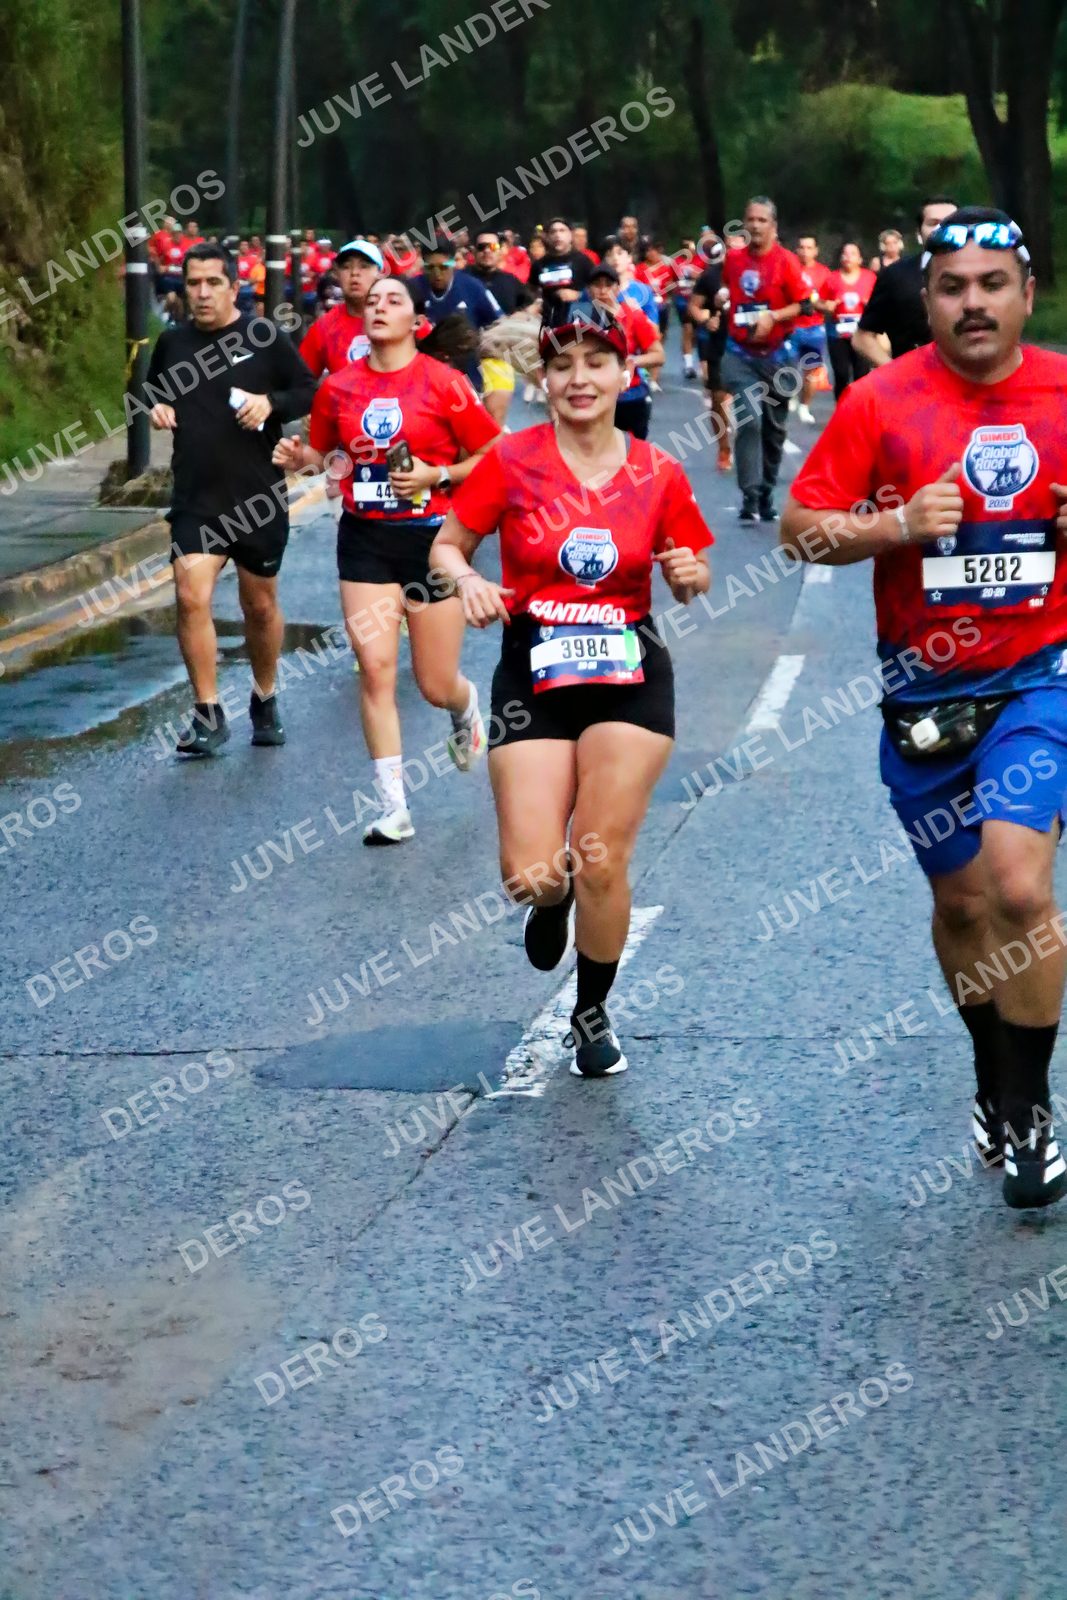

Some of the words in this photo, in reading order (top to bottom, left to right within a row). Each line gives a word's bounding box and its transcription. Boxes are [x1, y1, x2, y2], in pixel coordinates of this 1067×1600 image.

[982, 445, 1019, 459] Global
[974, 458, 1006, 471] Race
[964, 555, 1022, 583] 5282
[528, 600, 626, 624] SANTIAGO
[561, 638, 609, 659] 3984
